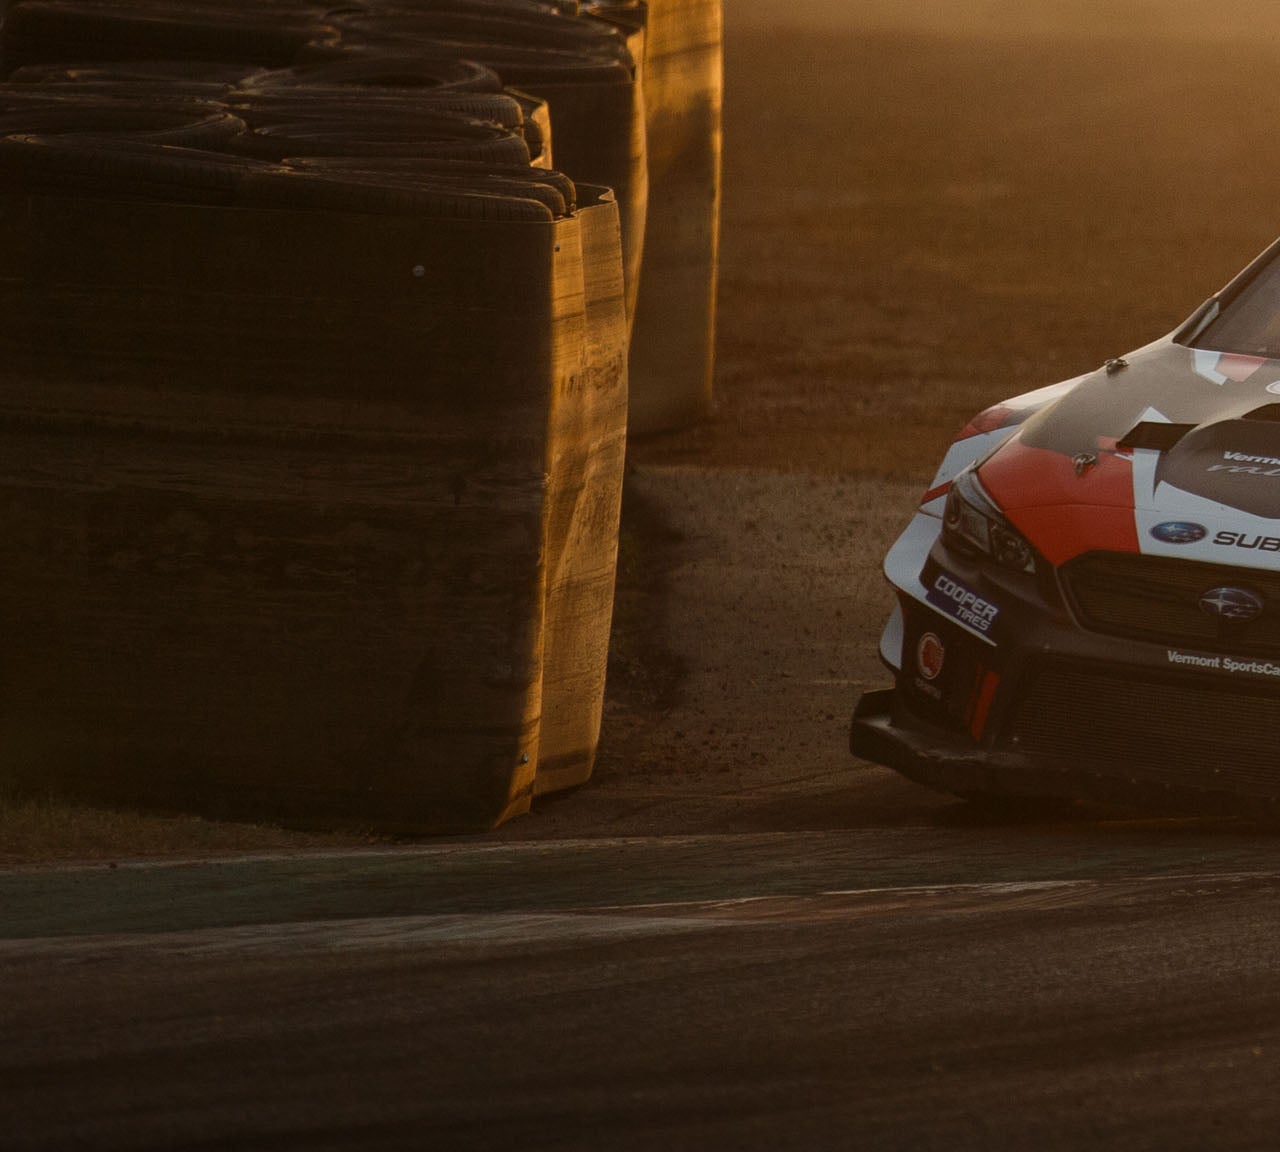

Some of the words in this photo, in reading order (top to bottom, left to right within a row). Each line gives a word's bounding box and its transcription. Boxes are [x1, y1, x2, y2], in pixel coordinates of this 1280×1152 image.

[935, 575, 998, 621] COOPER
[956, 605, 991, 631] TIRES
[1167, 650, 1220, 668] Vermont
